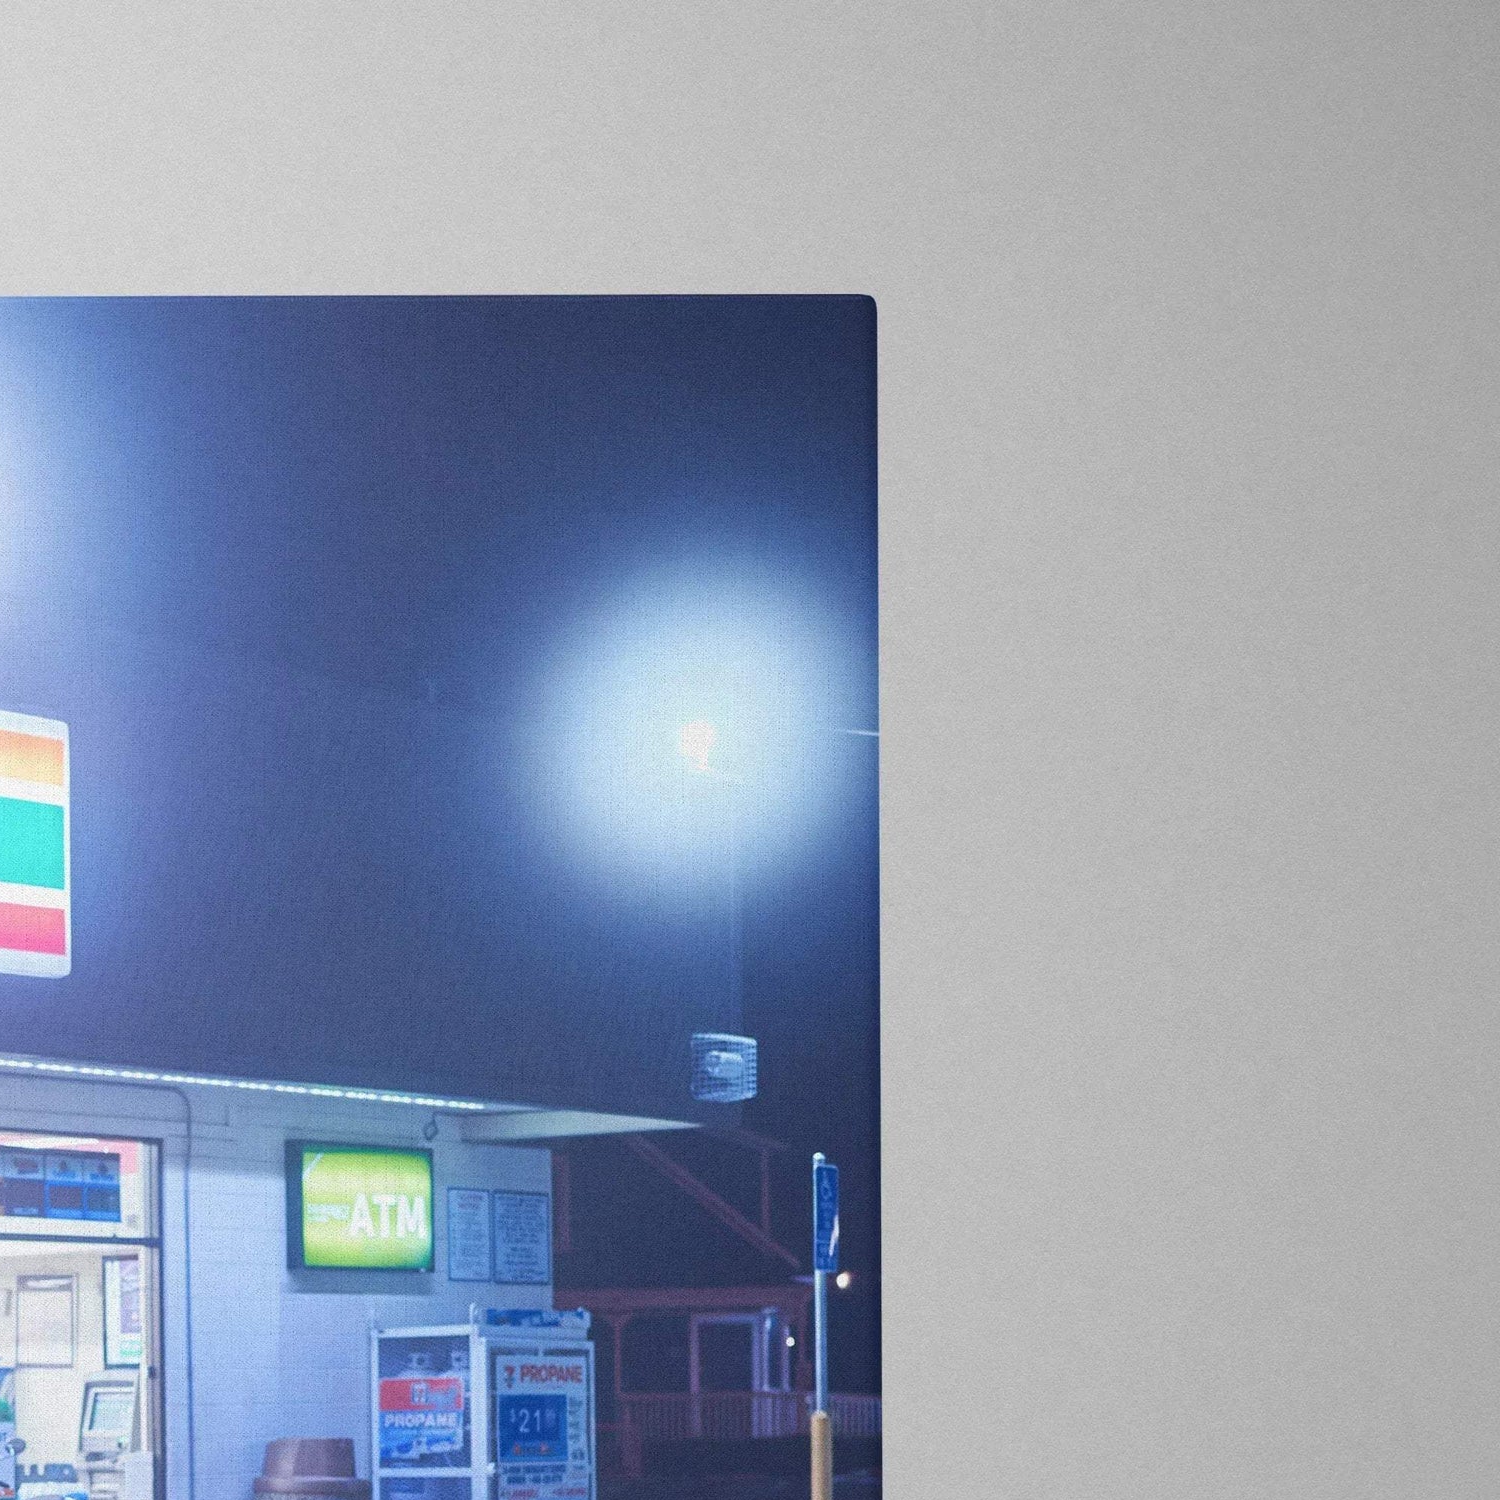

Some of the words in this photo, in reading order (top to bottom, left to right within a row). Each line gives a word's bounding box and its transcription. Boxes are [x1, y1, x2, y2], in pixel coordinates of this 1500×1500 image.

[349, 1193, 426, 1239] ATM
[519, 1363, 583, 1385] PROPANE
[383, 1411, 457, 1429] PROPANE
